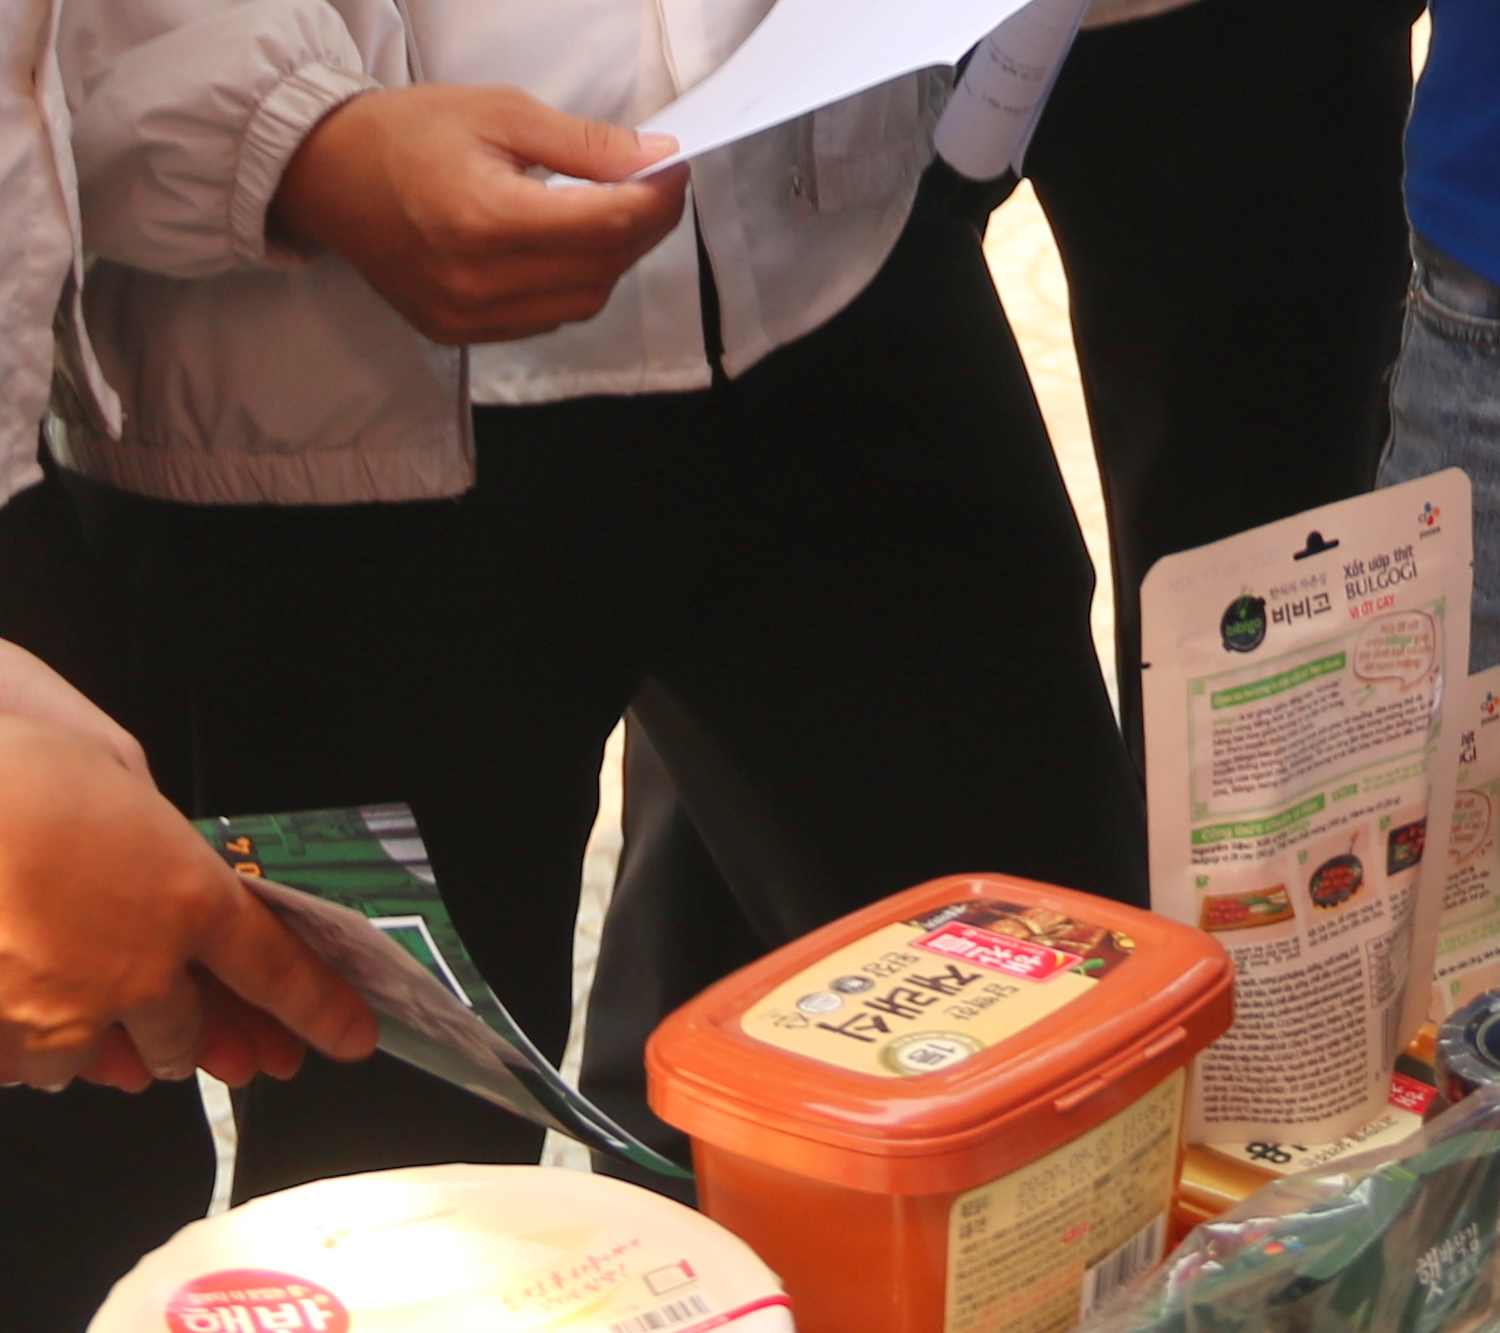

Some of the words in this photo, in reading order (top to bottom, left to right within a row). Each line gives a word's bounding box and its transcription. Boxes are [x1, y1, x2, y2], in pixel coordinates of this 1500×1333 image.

[1393, 544, 1414, 563] thịt
[1345, 562, 1417, 600] BULGOGI
[1272, 593, 1332, 625] 비비고
[1225, 617, 1263, 637] bibigo
[816, 964, 982, 1043] 재래식
